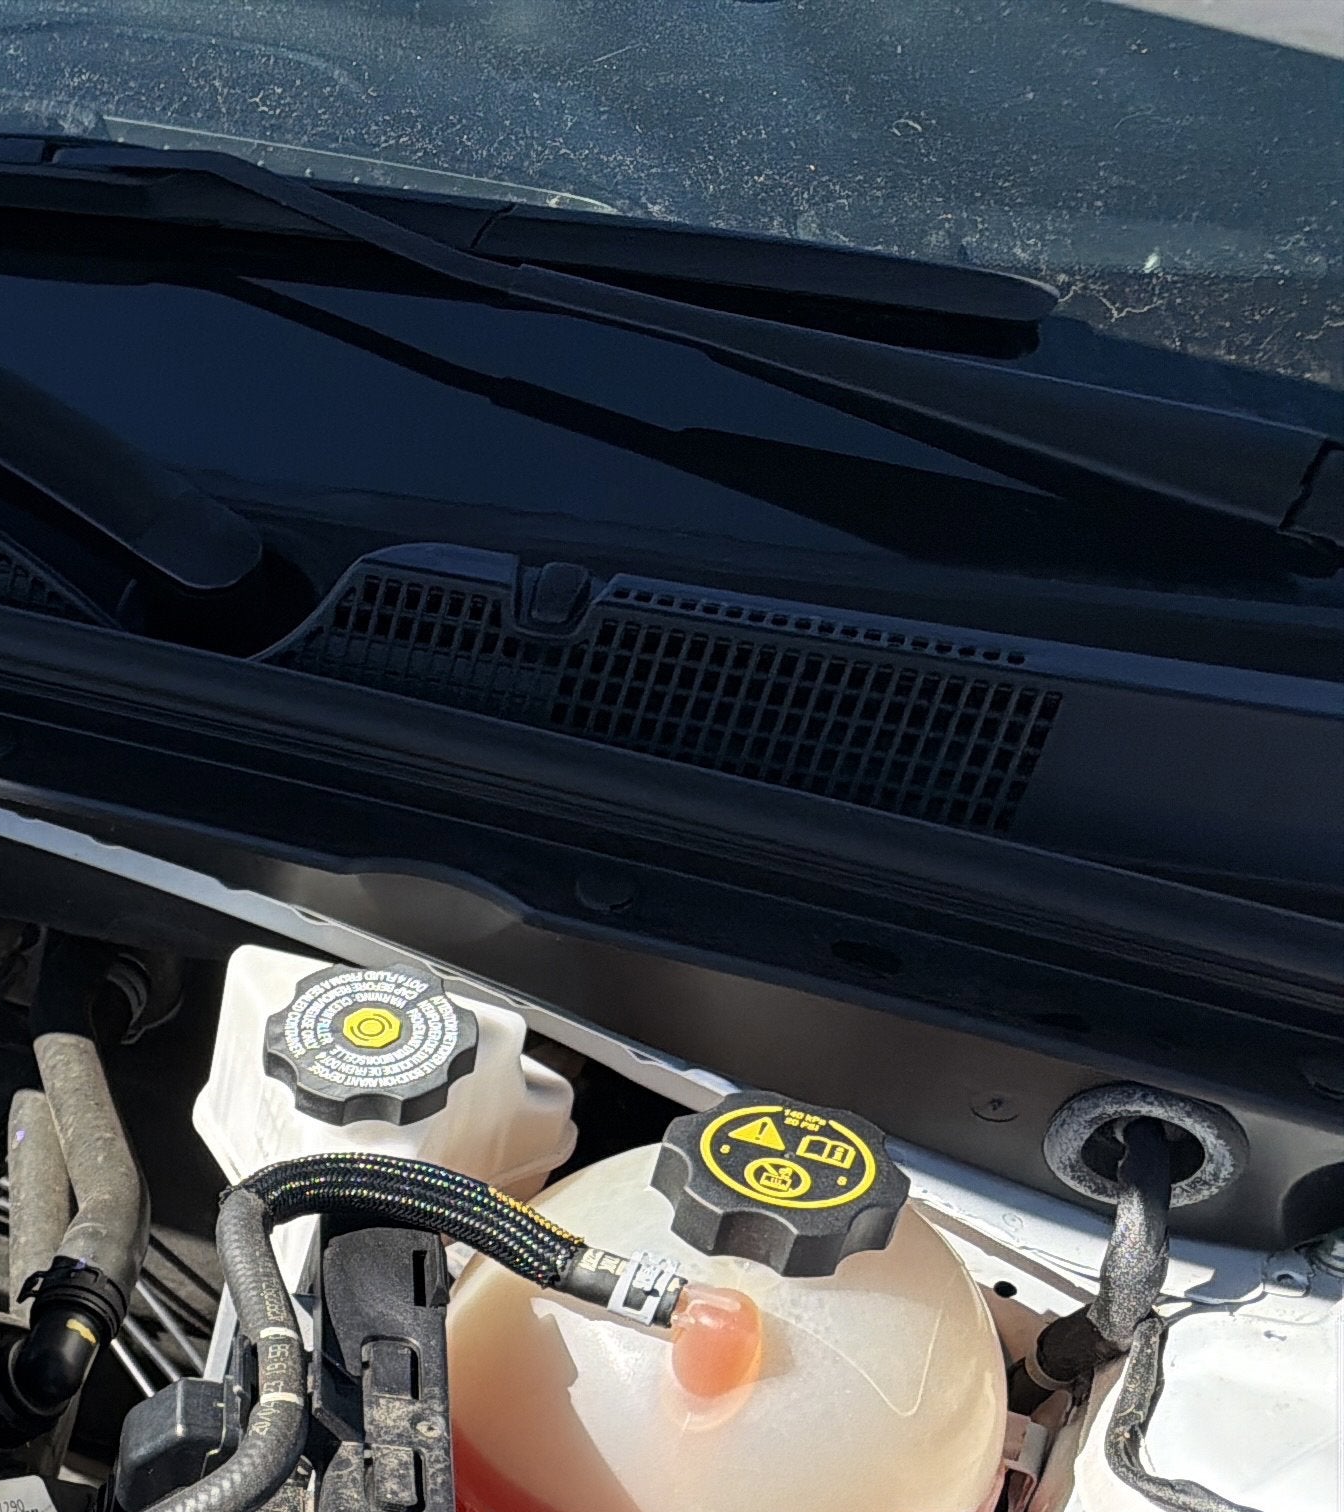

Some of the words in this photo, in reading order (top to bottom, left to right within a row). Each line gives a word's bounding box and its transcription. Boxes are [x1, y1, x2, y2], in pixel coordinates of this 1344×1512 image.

[325, 969, 363, 986] FROM
[363, 969, 399, 981] FLUID
[349, 980, 396, 992] BEFORE
[393, 984, 419, 1000] CAP
[403, 976, 430, 993] DOT
[290, 983, 324, 1012] SEALED
[319, 994, 353, 1018] CLEAN
[301, 1029, 319, 1051] ONLY
[318, 1055, 340, 1070] DOT
[335, 1063, 367, 1078] FREIN
[367, 1069, 383, 1078] DE
[343, 1077, 379, 1089] AVANT
[379, 1068, 427, 1089] BOUCHON
[784, 1108, 804, 1121] 140
[784, 1117, 799, 1127] 20
[800, 1121, 821, 1132] PSI
